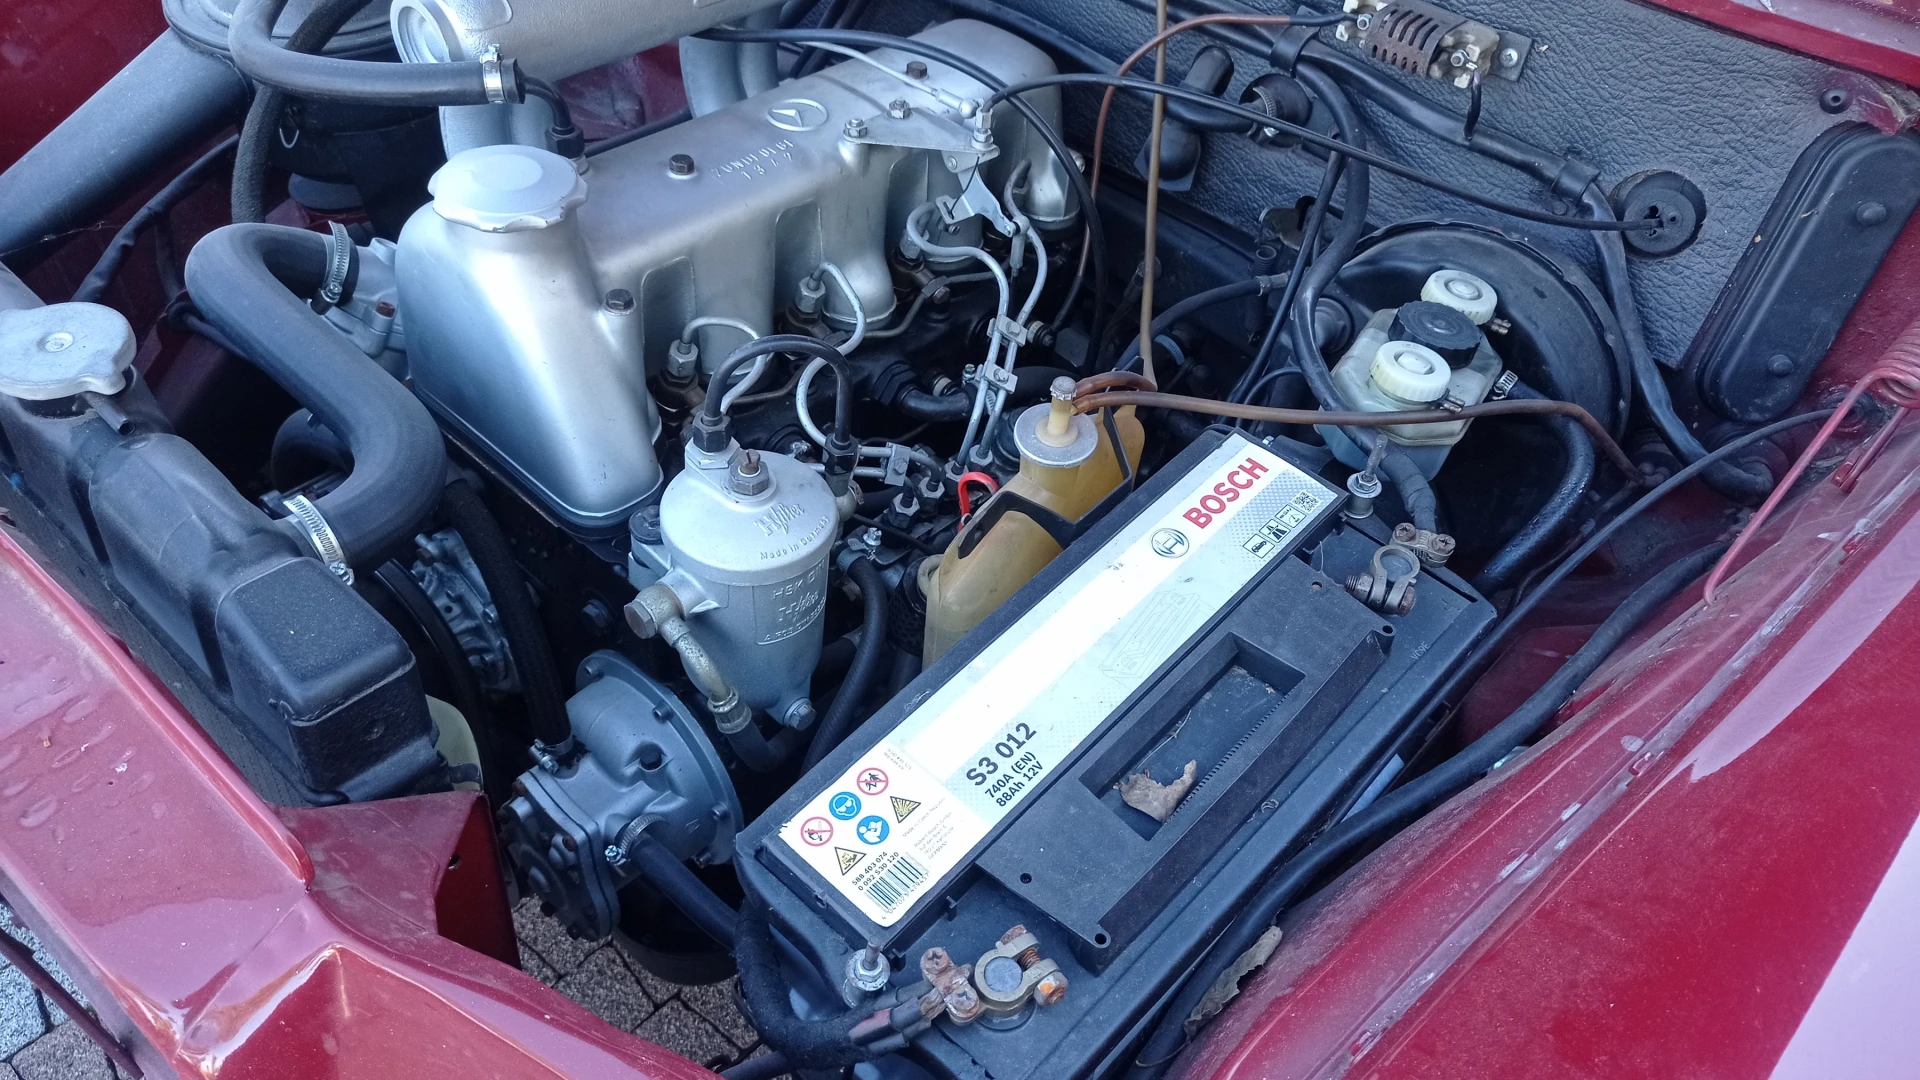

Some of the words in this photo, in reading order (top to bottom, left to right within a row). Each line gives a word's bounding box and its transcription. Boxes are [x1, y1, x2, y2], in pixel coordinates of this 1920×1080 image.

[1183, 457, 1269, 529] BOSCH
[966, 756, 999, 786] S3
[995, 722, 1037, 758] 012
[985, 773, 1015, 798] 740A
[1011, 751, 1037, 774] (EN)
[996, 781, 1025, 807] 88Ah
[1023, 760, 1043, 782] 12V
[852, 873, 865, 886] 588
[864, 862, 877, 874] 403
[876, 851, 888, 863] 074
[863, 874, 876, 886] 092
[887, 852, 899, 863] 120
